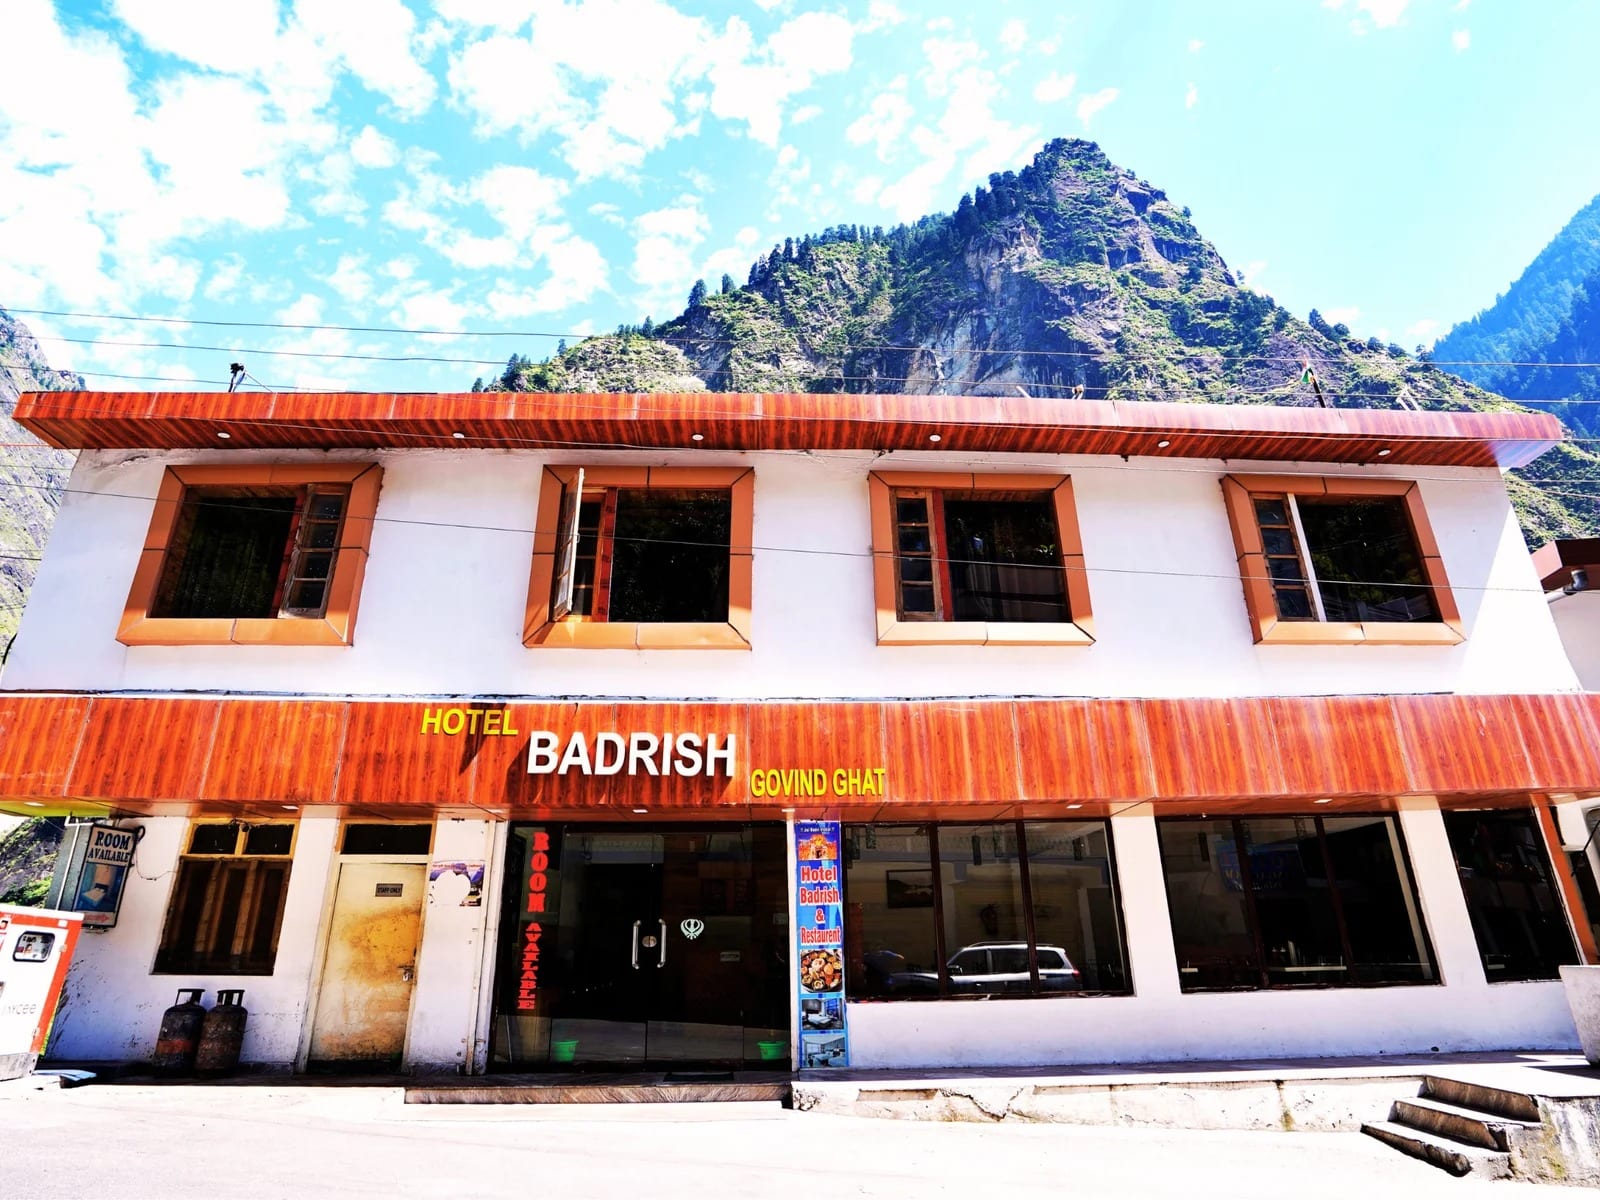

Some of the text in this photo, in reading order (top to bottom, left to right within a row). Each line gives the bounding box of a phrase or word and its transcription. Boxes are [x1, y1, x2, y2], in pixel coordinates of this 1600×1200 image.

[420, 707, 519, 736] HOTEL
[526, 730, 736, 777] BADRISH
[750, 768, 886, 798] GOVIND GHAT
[95, 831, 131, 850] ROOM
[88, 848, 130, 863] AVAILABLE
[801, 865, 837, 883] Hotel
[800, 886, 839, 905] Badrish
[517, 831, 550, 1010] ROOM AVAILABLE
[815, 909, 826, 923] &
[800, 926, 841, 946] Restaurent
